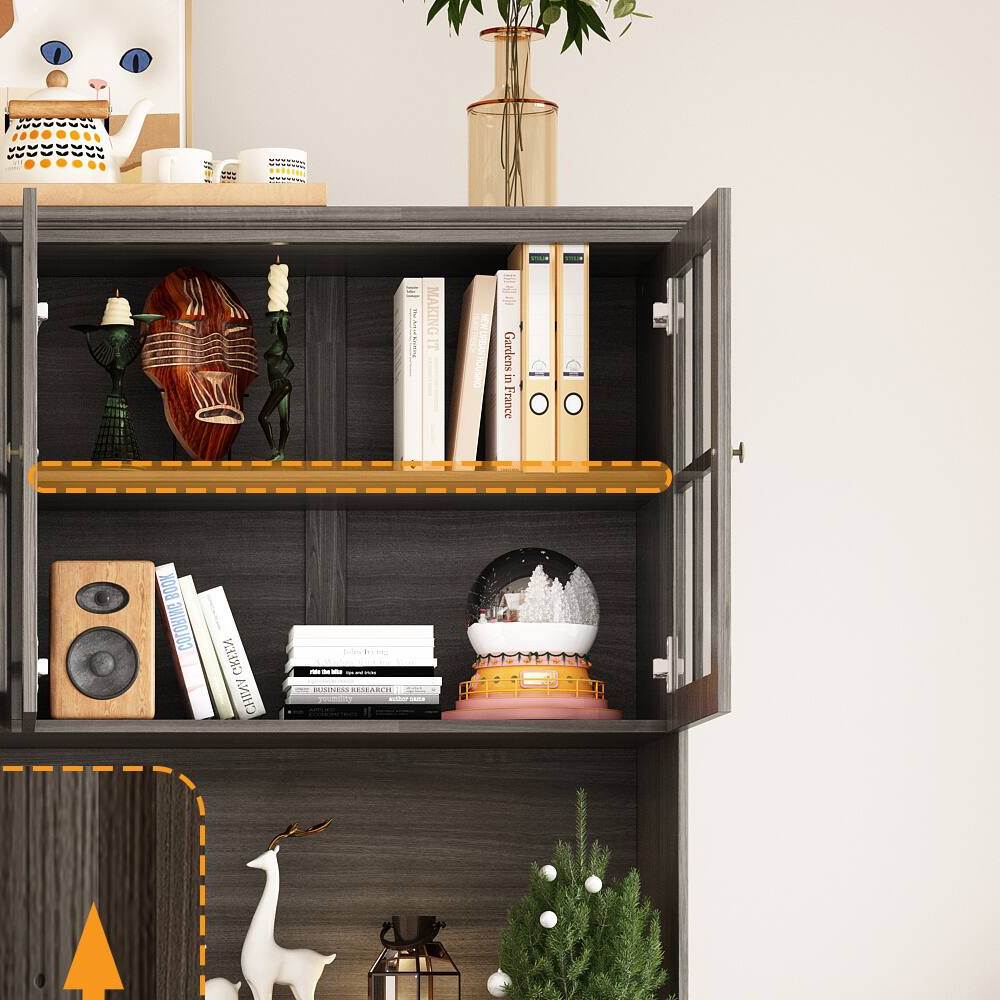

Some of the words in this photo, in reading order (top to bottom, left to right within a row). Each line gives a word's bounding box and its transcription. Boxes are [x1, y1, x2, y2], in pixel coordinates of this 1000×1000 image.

[427, 286, 439, 338] MAKING
[427, 339, 439, 351] IT
[504, 331, 516, 372] Gardens
[504, 373, 515, 383] in
[504, 385, 516, 419] France
